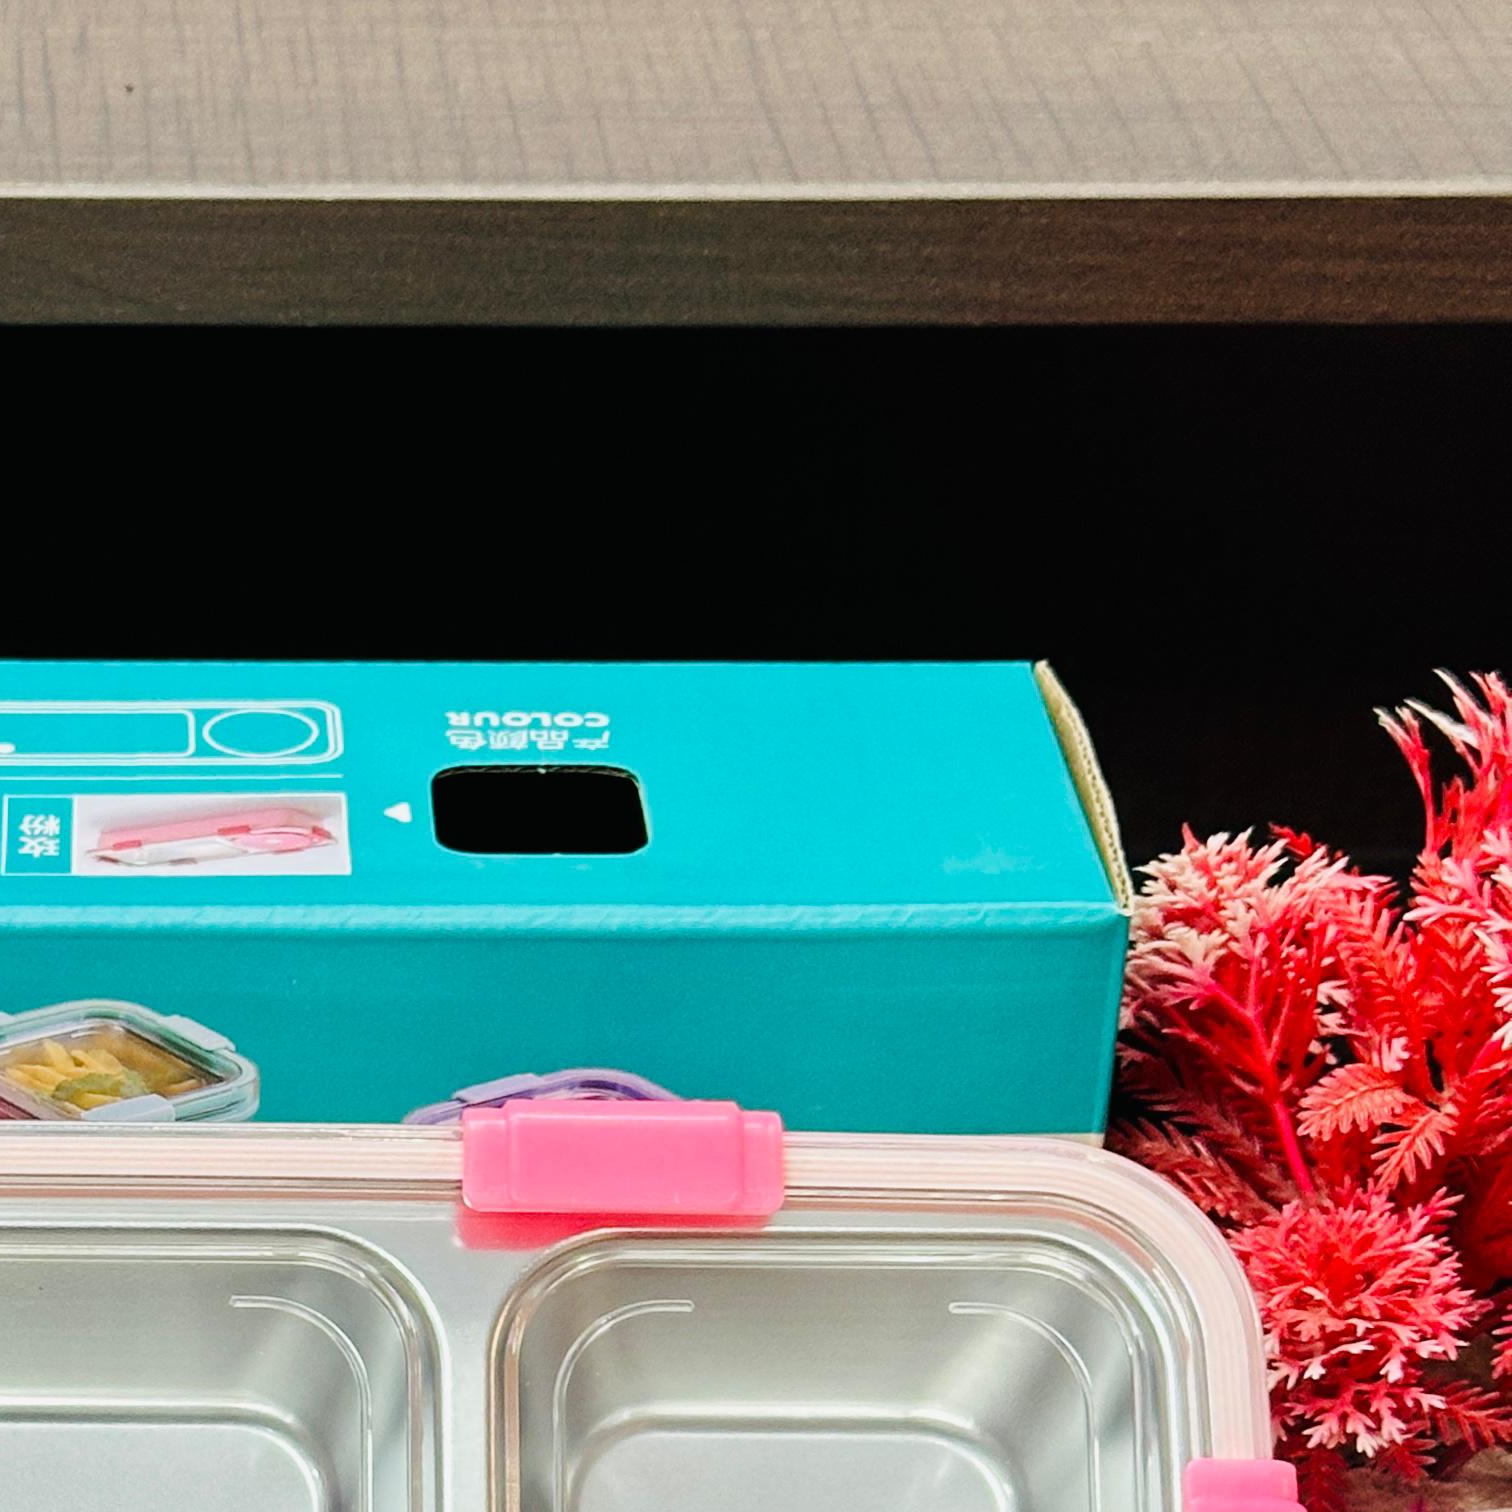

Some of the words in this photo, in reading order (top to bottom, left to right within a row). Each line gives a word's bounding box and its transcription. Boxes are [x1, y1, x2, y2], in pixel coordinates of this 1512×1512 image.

[445, 712, 610, 727] COLOUR
[445, 729, 611, 751] 产品颜色
[18, 813, 62, 858] 玫粉
